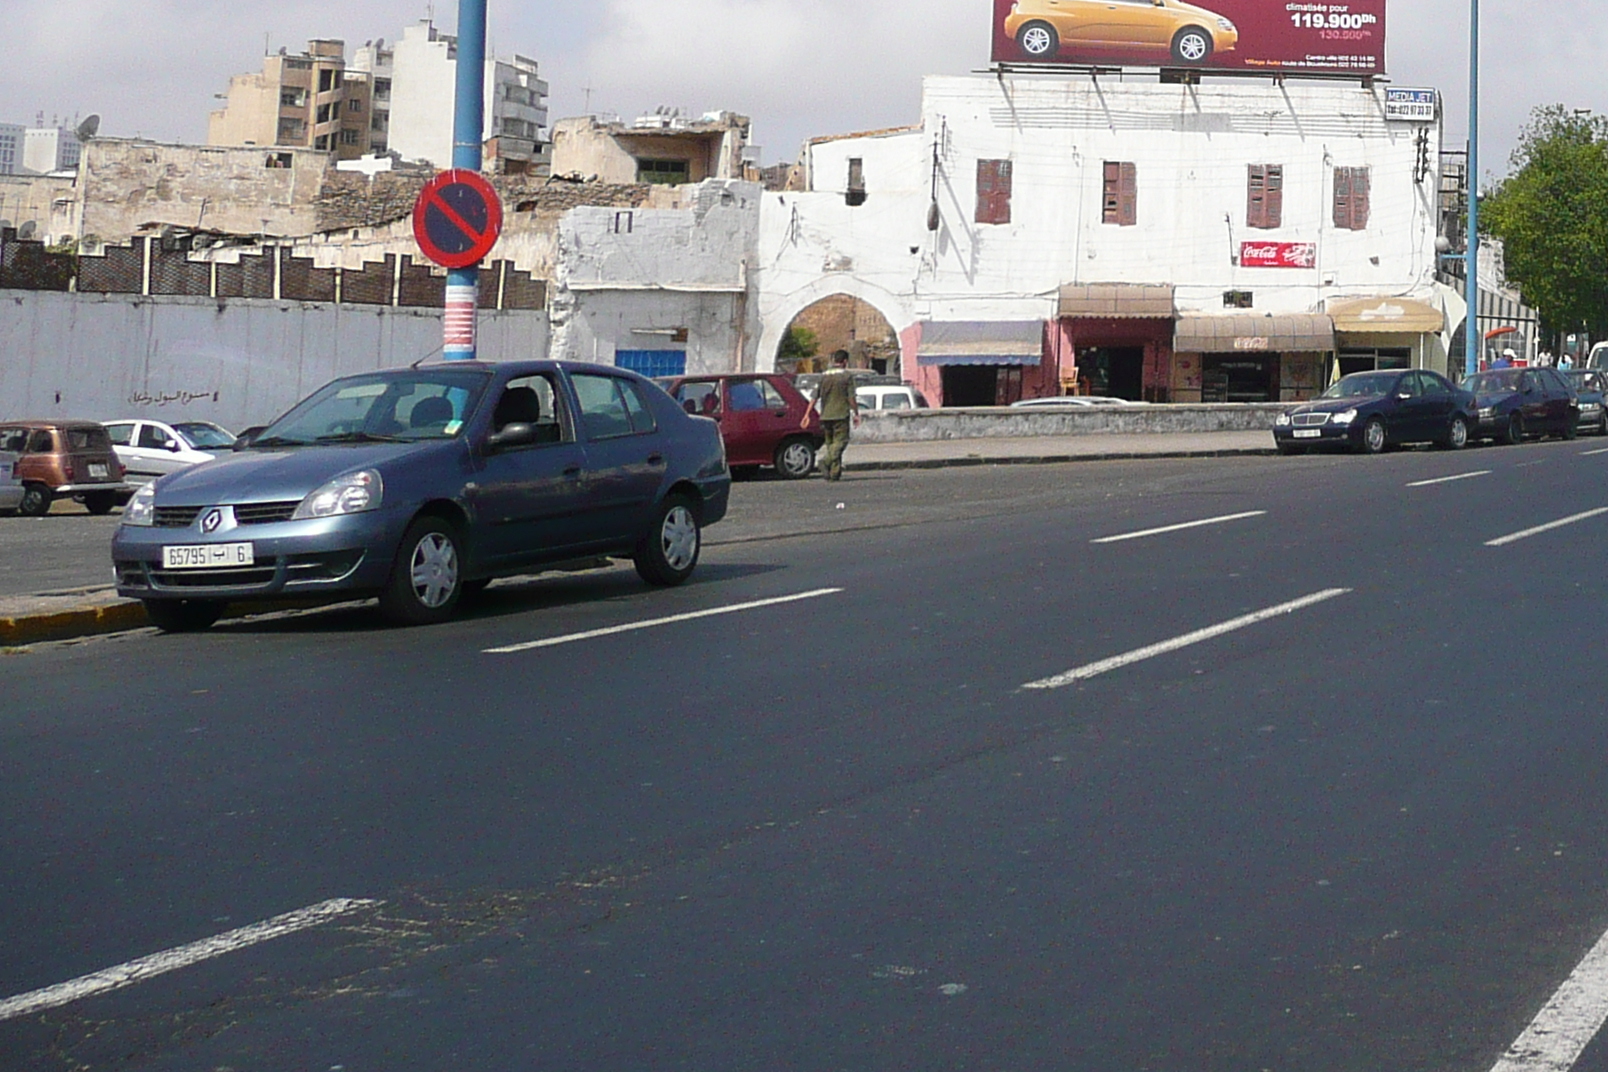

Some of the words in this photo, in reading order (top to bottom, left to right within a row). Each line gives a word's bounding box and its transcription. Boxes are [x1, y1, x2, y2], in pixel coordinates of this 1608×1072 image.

[1328, 5, 1349, 14] pour
[1388, 91, 1414, 102] MEDIA
[1415, 92, 1431, 103] JET
[169, 547, 206, 565] 65795
[237, 545, 245, 562] 6
